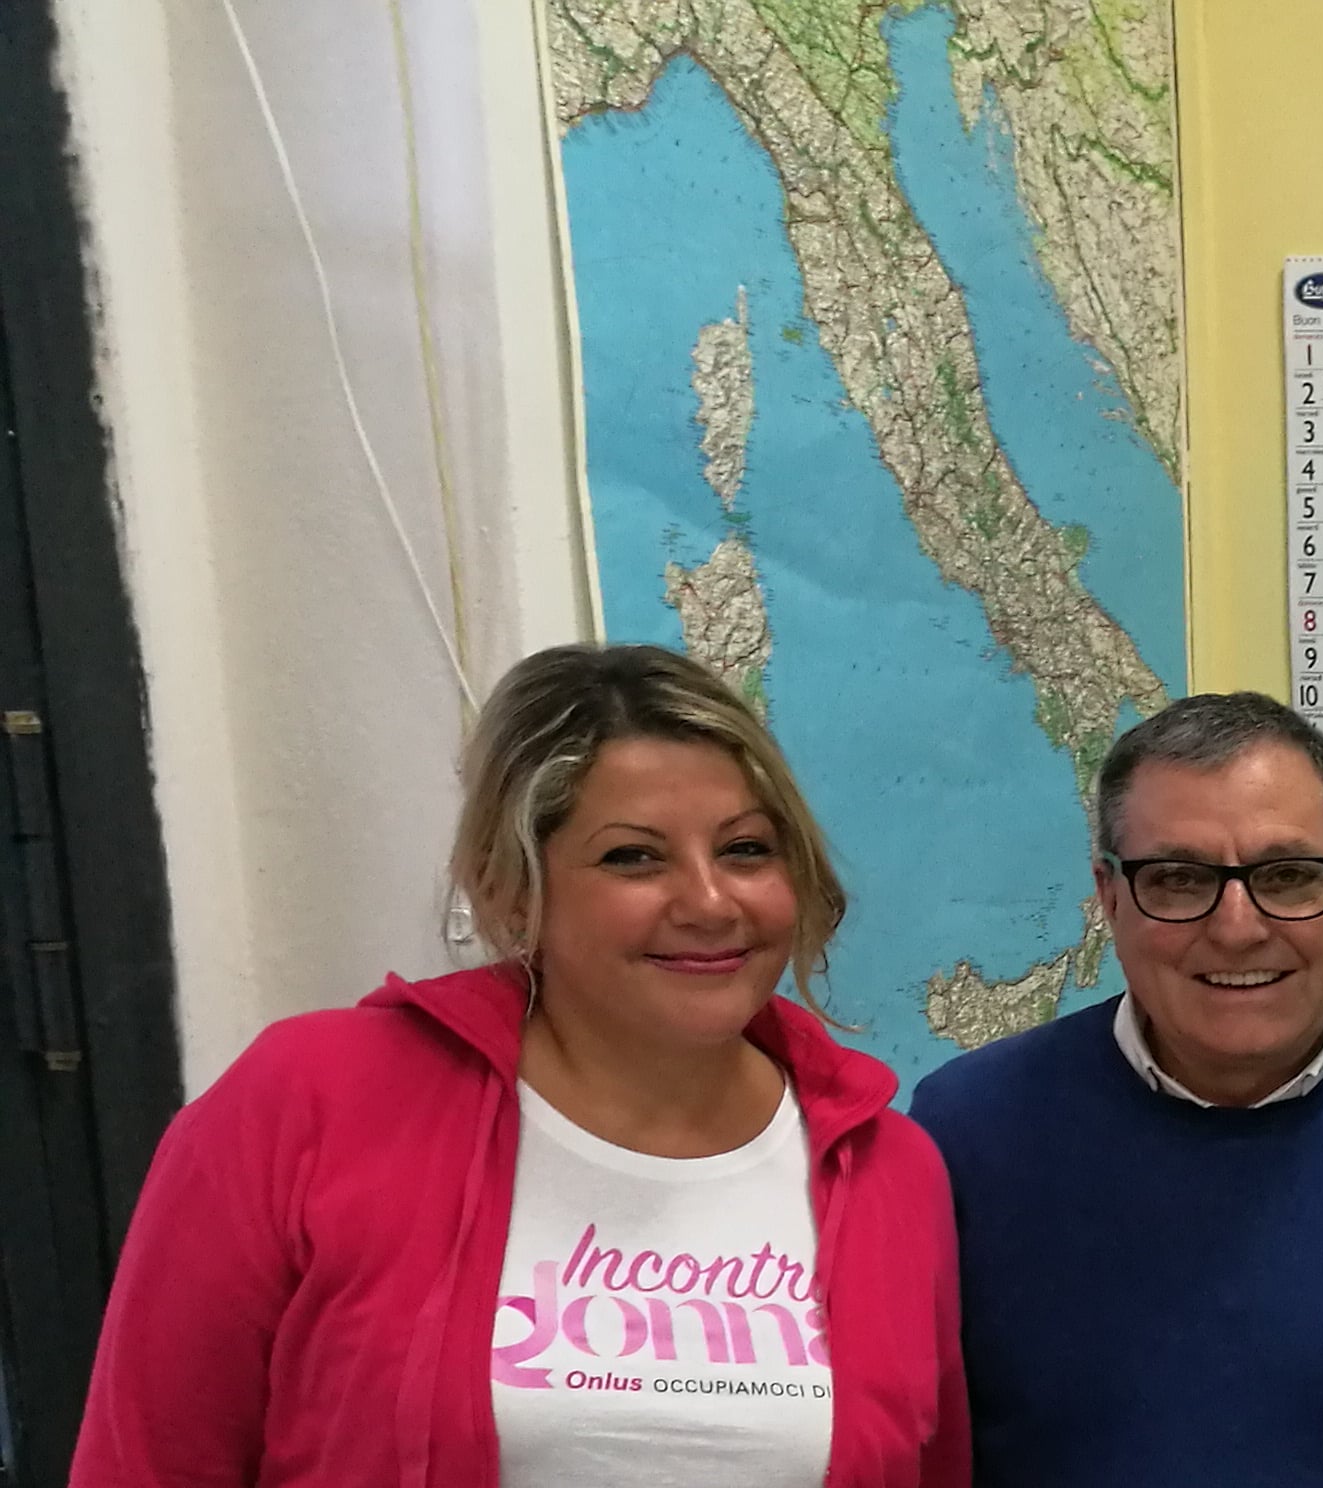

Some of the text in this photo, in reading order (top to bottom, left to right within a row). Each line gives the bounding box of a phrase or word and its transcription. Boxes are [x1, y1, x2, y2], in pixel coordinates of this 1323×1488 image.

[1302, 382, 1316, 404] 2
[1303, 420, 1315, 442] 3
[1301, 459, 1316, 480] 4
[1303, 496, 1315, 518] 5
[1303, 534, 1316, 556] 6
[1303, 572, 1317, 593] 7
[1304, 610, 1316, 631] 8
[1304, 647, 1317, 669] 9
[1300, 685, 1318, 706] 10
[565, 1371, 832, 1399] Onlus OCCUPIAMOCI DI
